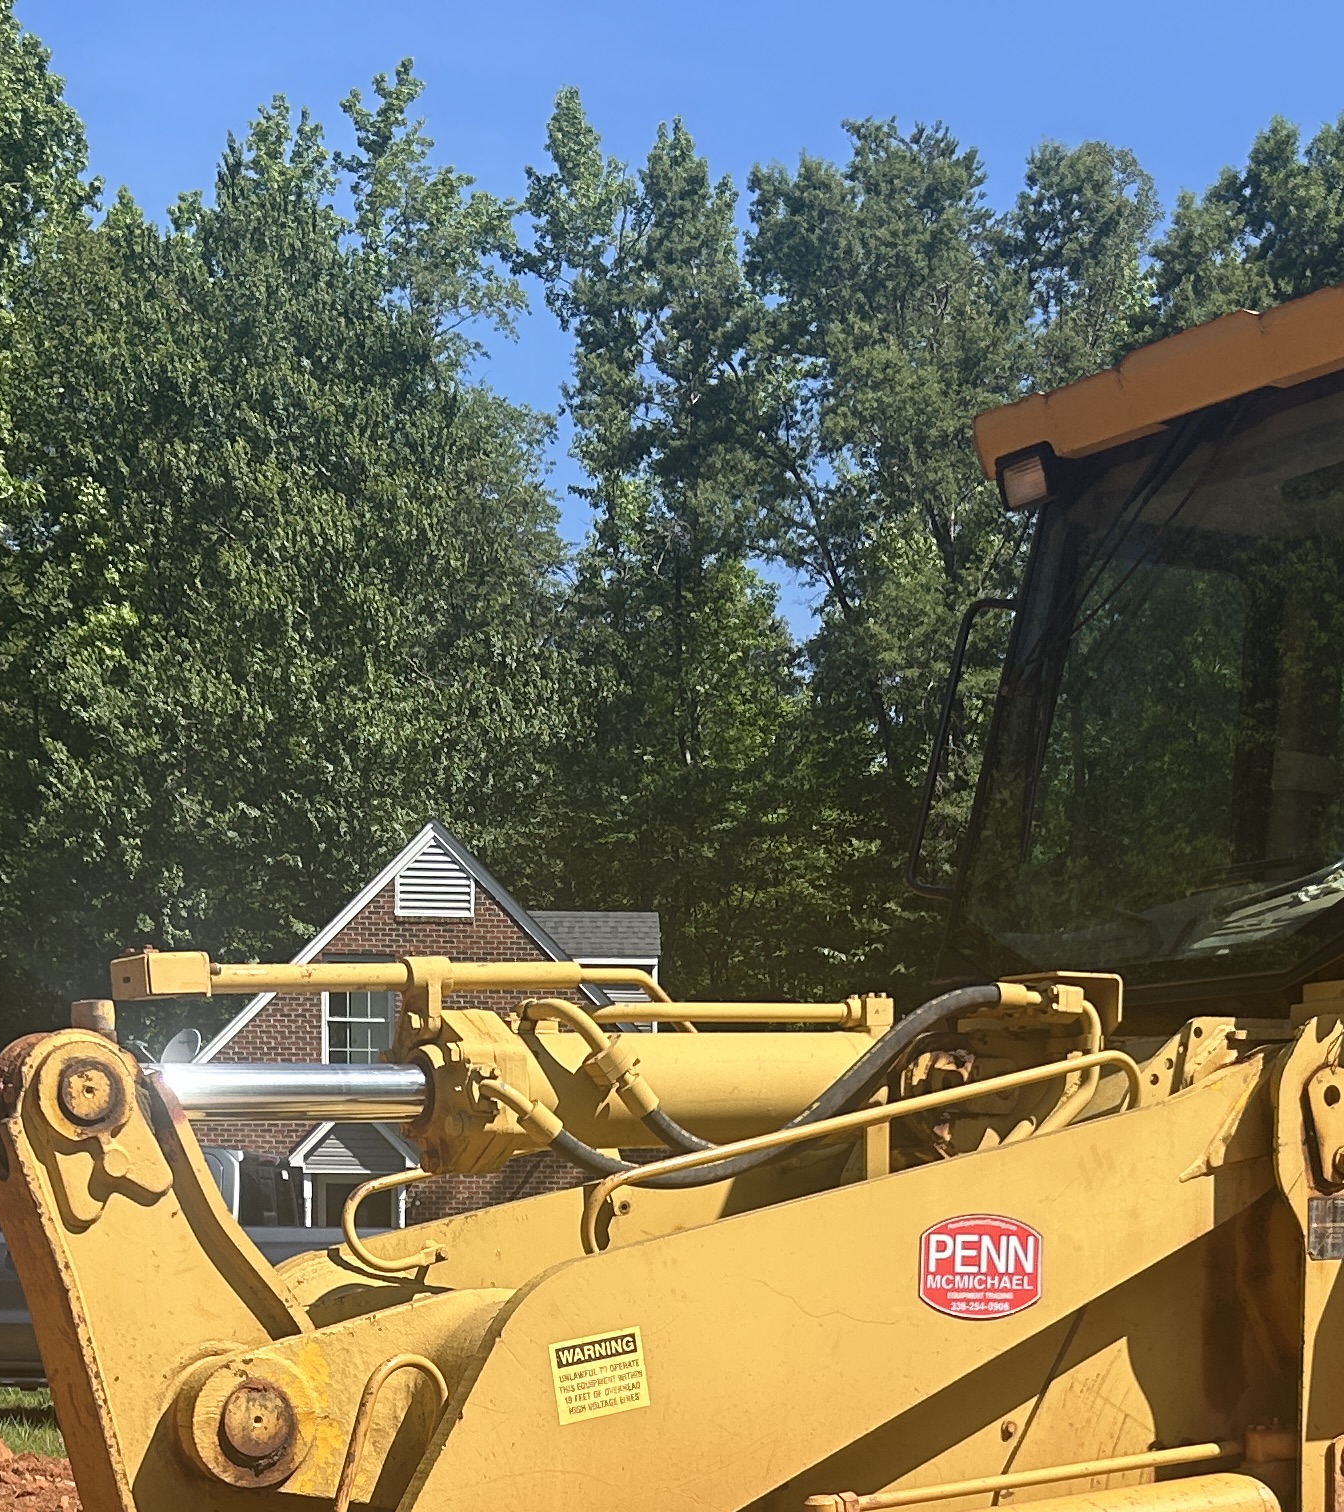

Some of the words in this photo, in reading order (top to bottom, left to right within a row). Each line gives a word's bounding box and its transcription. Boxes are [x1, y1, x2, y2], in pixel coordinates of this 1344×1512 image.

[927, 1234, 1035, 1274] PENN
[926, 1275, 1034, 1290] MCMICHAEL
[558, 1336, 635, 1365] WARNING
[558, 1384, 575, 1394] THIS
[577, 1375, 616, 1391] EQUIPMENT
[618, 1370, 643, 1381] WITHIN
[559, 1368, 598, 1382] UNLAWFUL
[599, 1366, 608, 1374] TO
[610, 1359, 640, 1372] OPERATE
[568, 1404, 587, 1415] HIGH
[588, 1397, 618, 1411] VOLTAGE
[620, 1391, 641, 1404] LINES
[575, 1391, 591, 1403] FEET
[593, 1390, 602, 1398] OF
[604, 1381, 641, 1396] OVERHEAD
